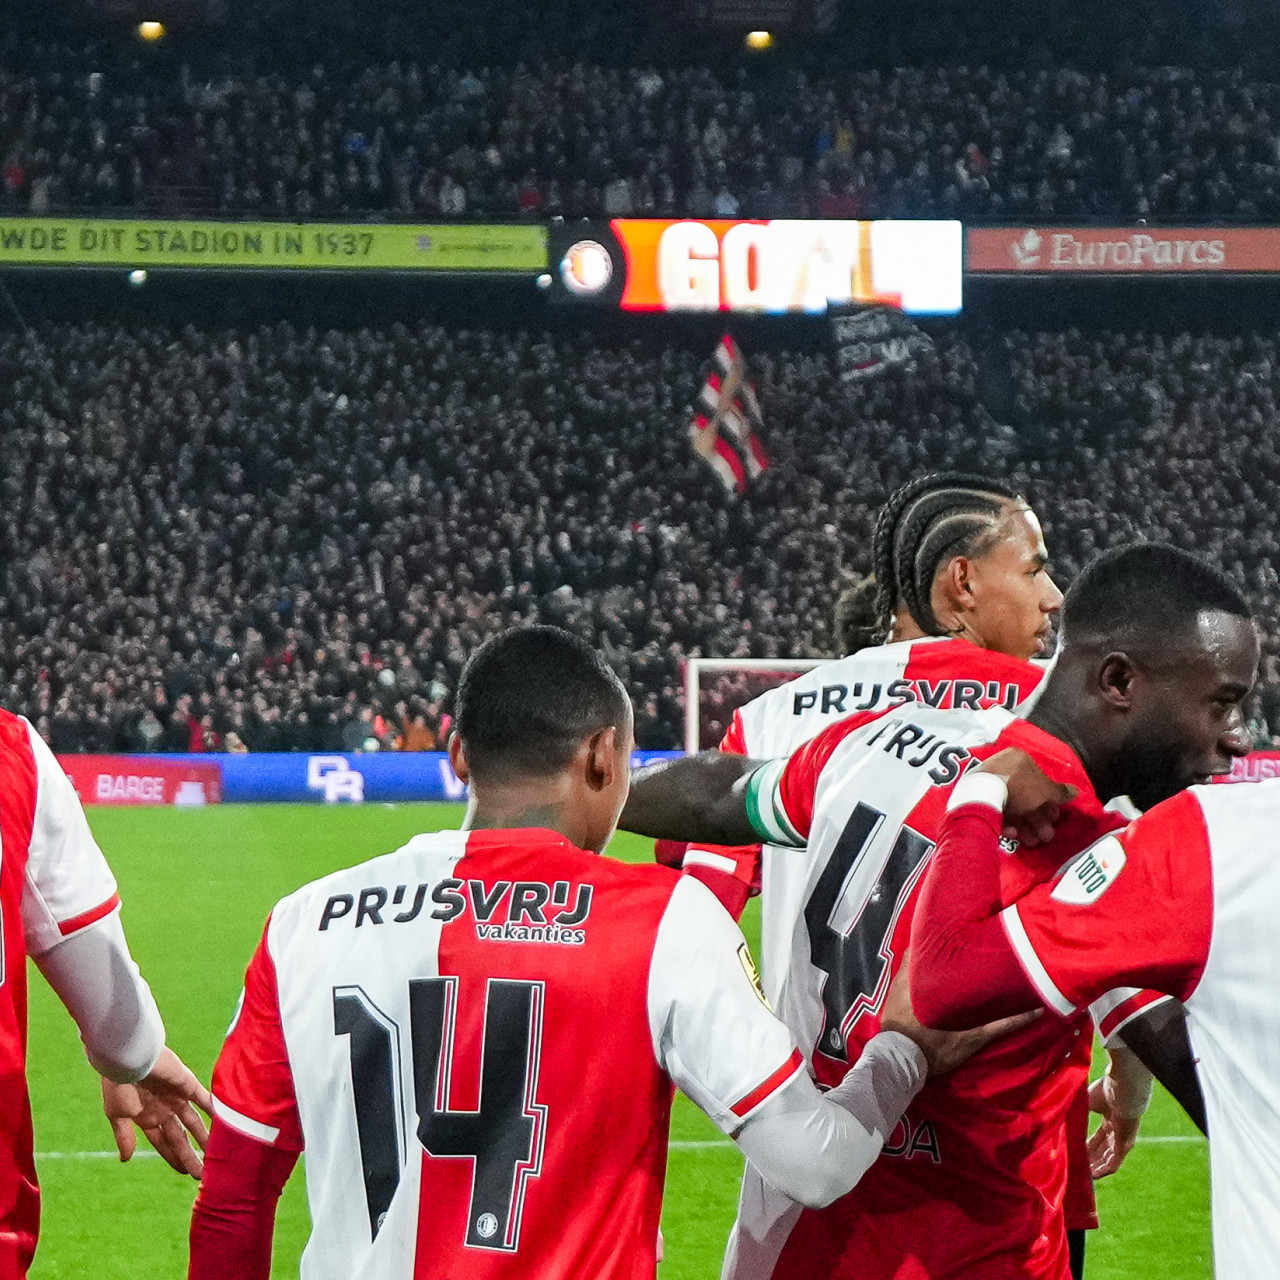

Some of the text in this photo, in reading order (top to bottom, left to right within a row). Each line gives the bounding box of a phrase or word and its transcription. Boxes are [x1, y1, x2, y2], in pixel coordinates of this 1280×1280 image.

[79, 229, 125, 252] DIT
[136, 229, 263, 255] STADION
[274, 231, 304, 256] IN
[319, 232, 373, 256] 1937
[1051, 233, 1224, 266] EuroParcs
[866, 718, 982, 788] PRIJS
[96, 773, 166, 800] BARGE
[1075, 852, 1107, 894] TOTO
[475, 921, 586, 945] vakanties
[805, 800, 936, 1063] 4
[332, 976, 549, 1253] 14
